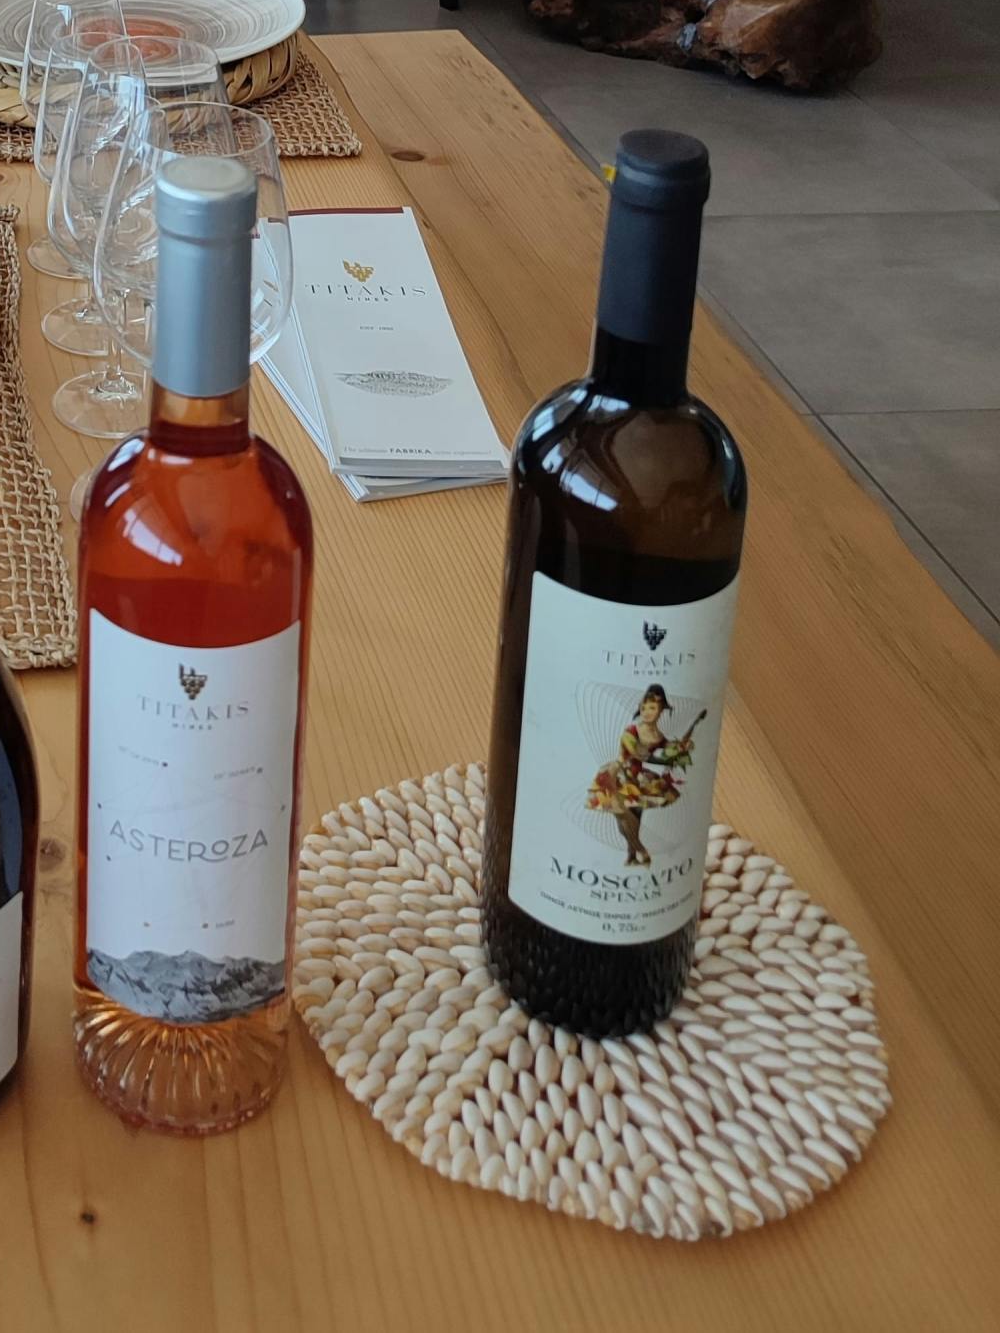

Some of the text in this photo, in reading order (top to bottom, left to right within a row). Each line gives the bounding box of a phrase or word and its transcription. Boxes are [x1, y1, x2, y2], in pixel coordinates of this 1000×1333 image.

[304, 284, 426, 296] TITAKIS
[602, 649, 696, 667] TITAKIS
[137, 693, 250, 721] TITAKIS
[109, 820, 268, 863] ASTEROZA
[551, 856, 693, 891] MOSCATO
